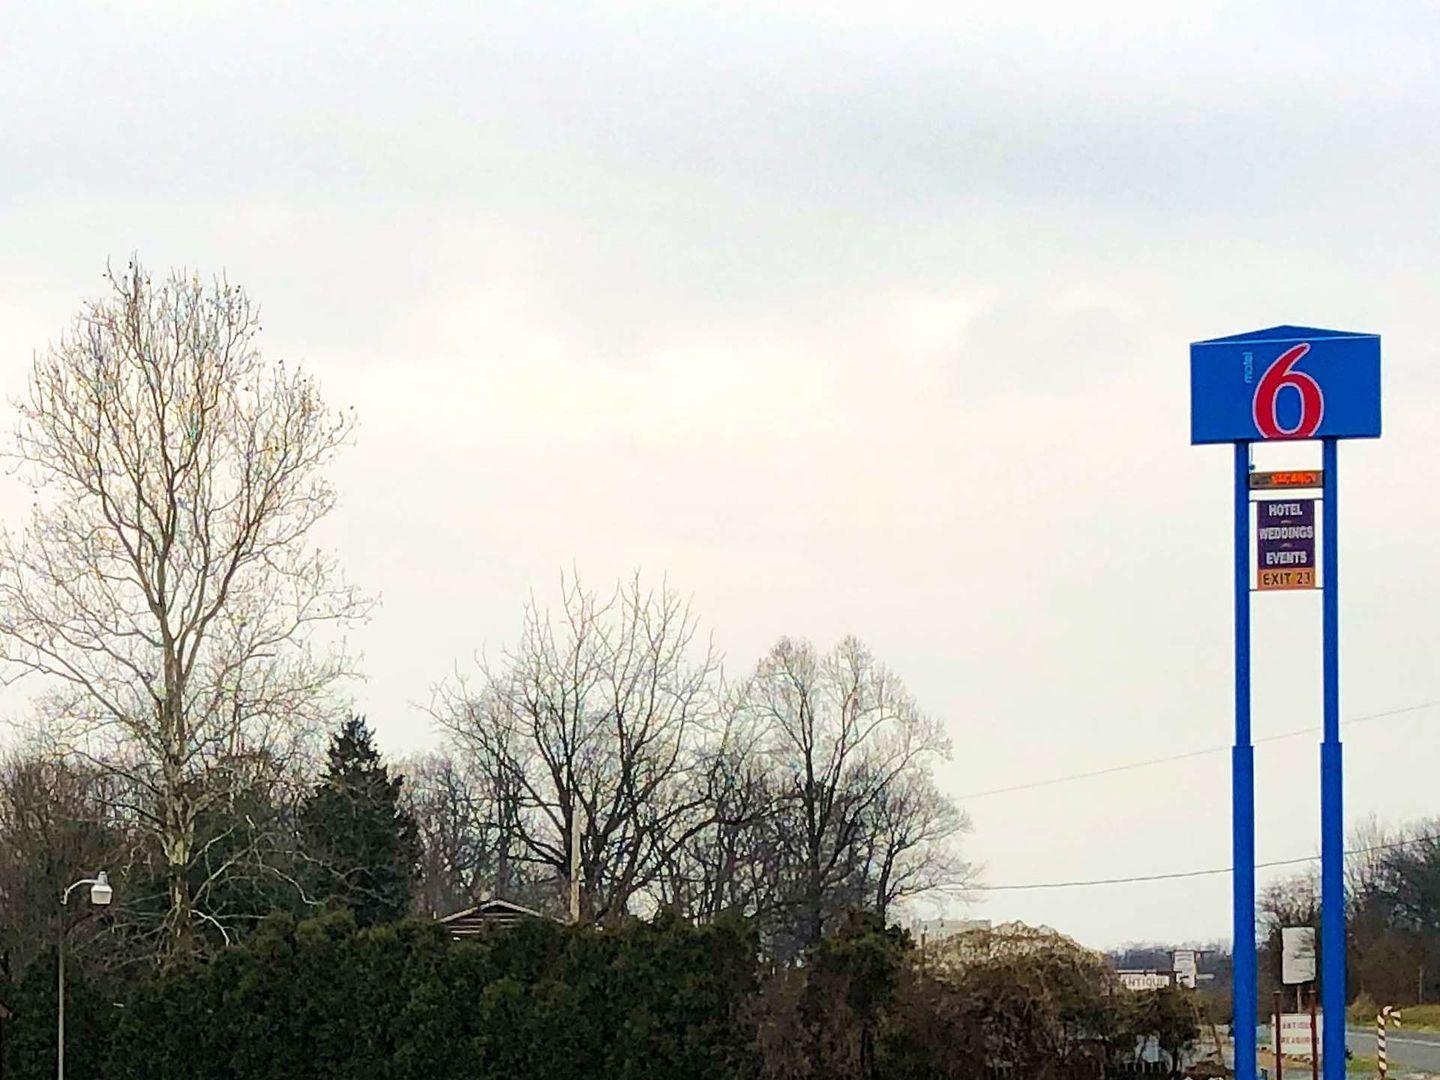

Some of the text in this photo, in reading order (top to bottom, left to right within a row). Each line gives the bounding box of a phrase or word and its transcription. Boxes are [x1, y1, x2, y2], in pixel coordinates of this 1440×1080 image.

[1252, 342, 1324, 438] 6
[1268, 503, 1303, 516] HOTEL
[1260, 525, 1314, 540] WEDDINGS
[1266, 551, 1307, 565] EVENTS
[1263, 573, 1291, 585] EXIT
